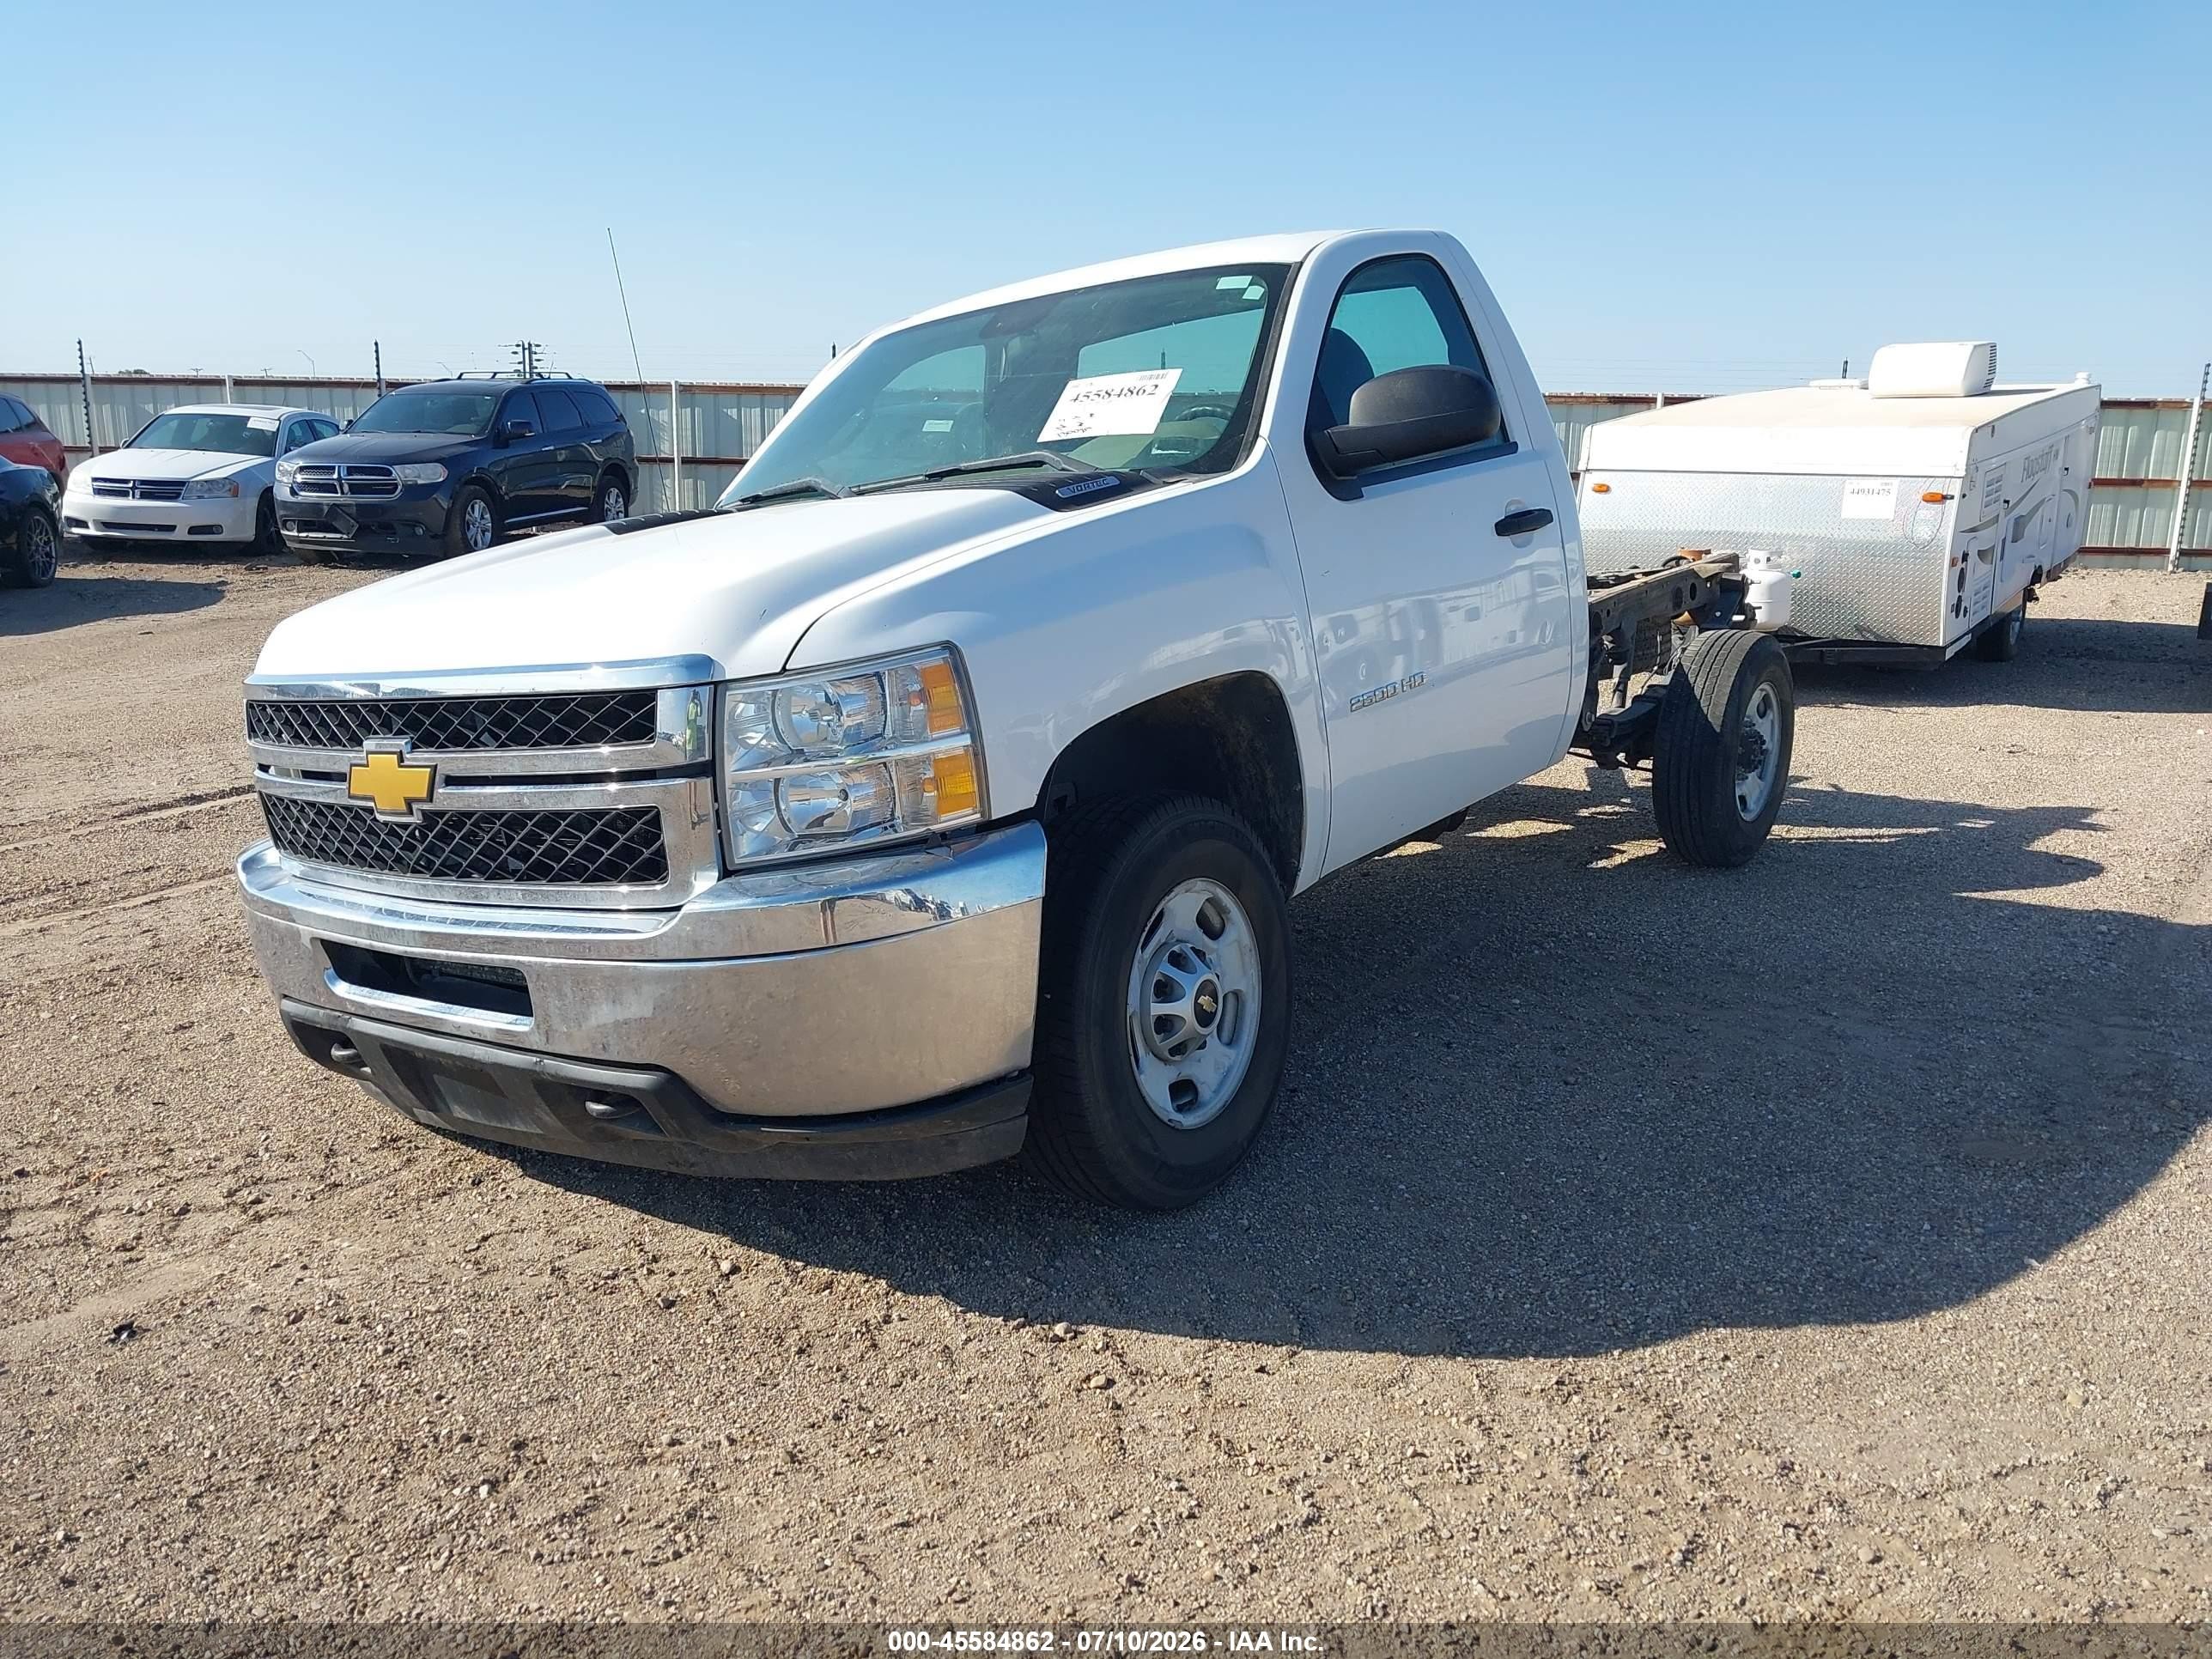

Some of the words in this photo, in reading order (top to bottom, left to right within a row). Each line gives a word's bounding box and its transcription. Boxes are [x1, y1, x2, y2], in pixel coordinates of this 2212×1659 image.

[1070, 384, 1160, 404] 45584862
[1066, 478, 1109, 494] VORTEC
[1349, 681, 1400, 714] 2500
[1401, 671, 1428, 693] HD
